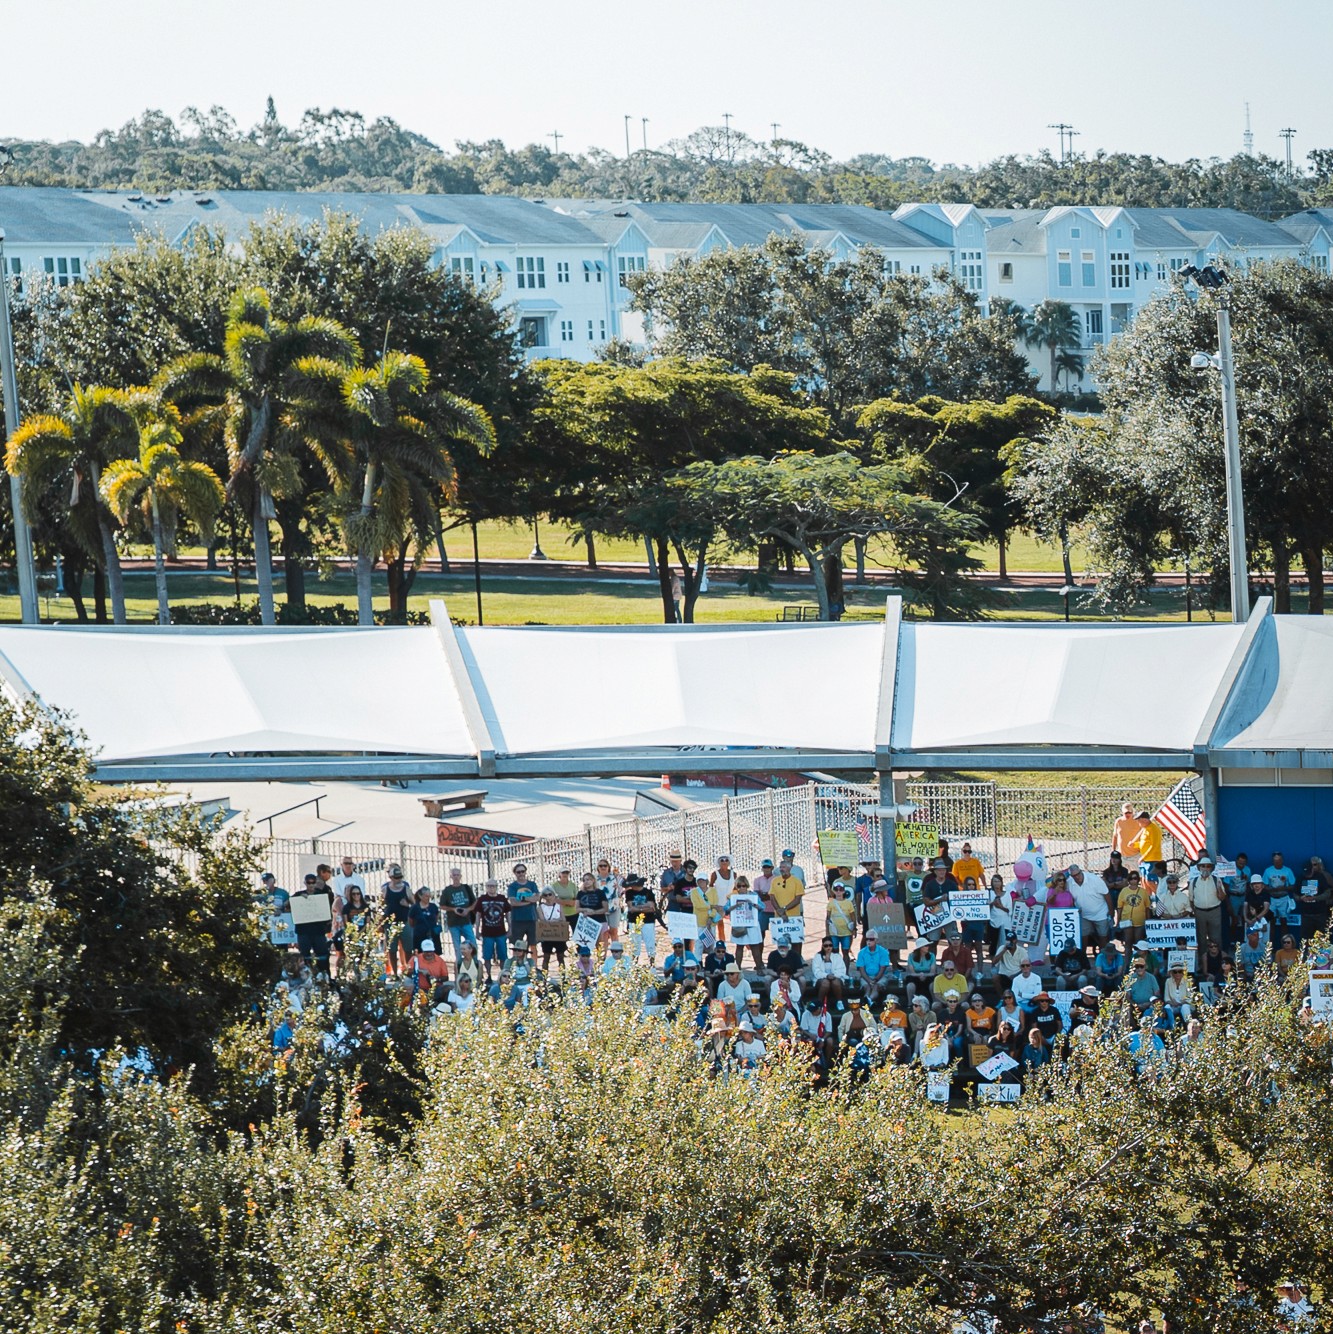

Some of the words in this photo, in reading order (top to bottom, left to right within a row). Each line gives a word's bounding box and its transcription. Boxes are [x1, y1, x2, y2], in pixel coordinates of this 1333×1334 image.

[911, 824, 937, 833] HATED
[895, 831, 938, 842] AMERICA
[903, 847, 912, 855] BE
[916, 848, 935, 857] HERE
[918, 914, 931, 927] NO
[923, 910, 950, 932] KINGS
[966, 912, 989, 920] KINGS
[1145, 923, 1163, 931] HELP
[1163, 922, 1179, 930] SAVE
[1181, 921, 1196, 929] OUR
[1052, 918, 1064, 949] STOP
